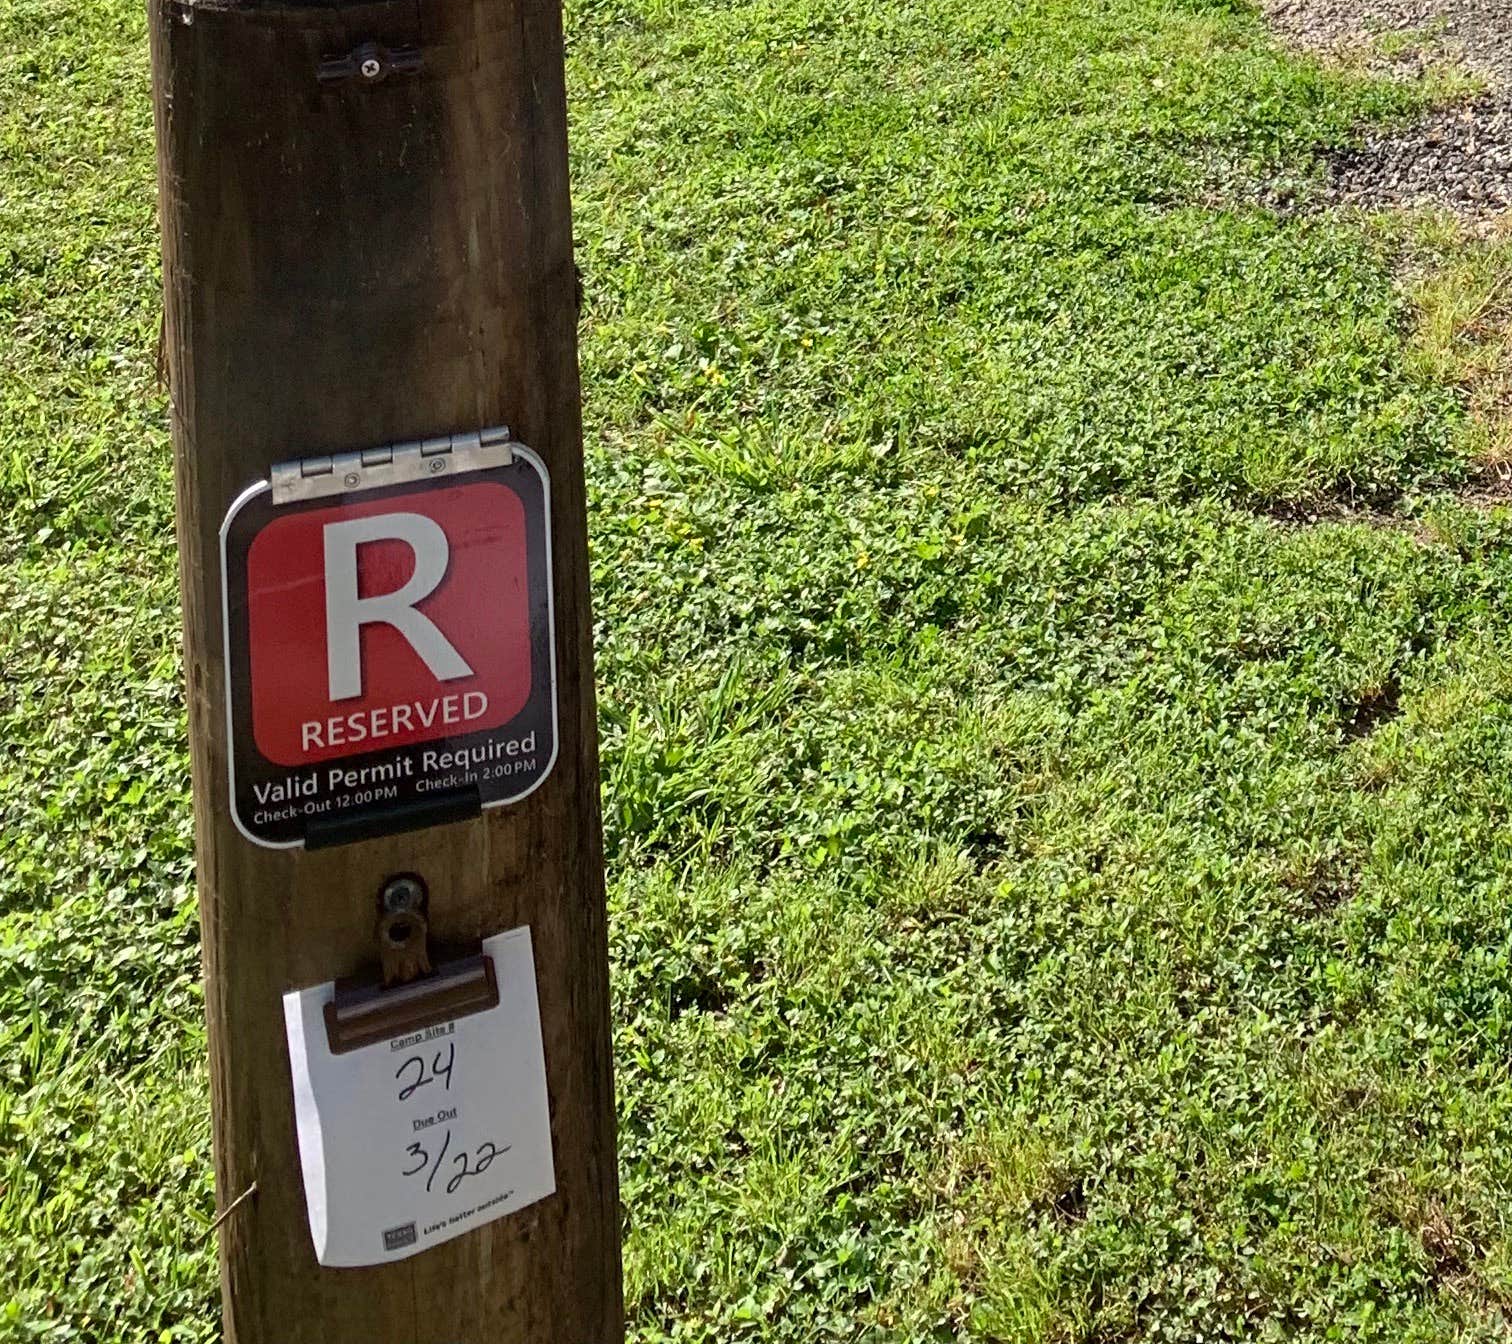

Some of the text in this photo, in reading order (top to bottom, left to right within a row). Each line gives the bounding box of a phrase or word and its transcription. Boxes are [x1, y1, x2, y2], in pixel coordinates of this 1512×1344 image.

[323, 512, 474, 702] R
[301, 691, 489, 752] RESERVED
[254, 730, 536, 805] Valid Permit Required
[415, 758, 537, 793] Check-In 2:00 PM
[254, 785, 398, 825] Check-Out 12:00 PM
[395, 1042, 455, 1101] 24
[412, 1108, 458, 1131] Due Out
[402, 1129, 511, 1193] 3/22
